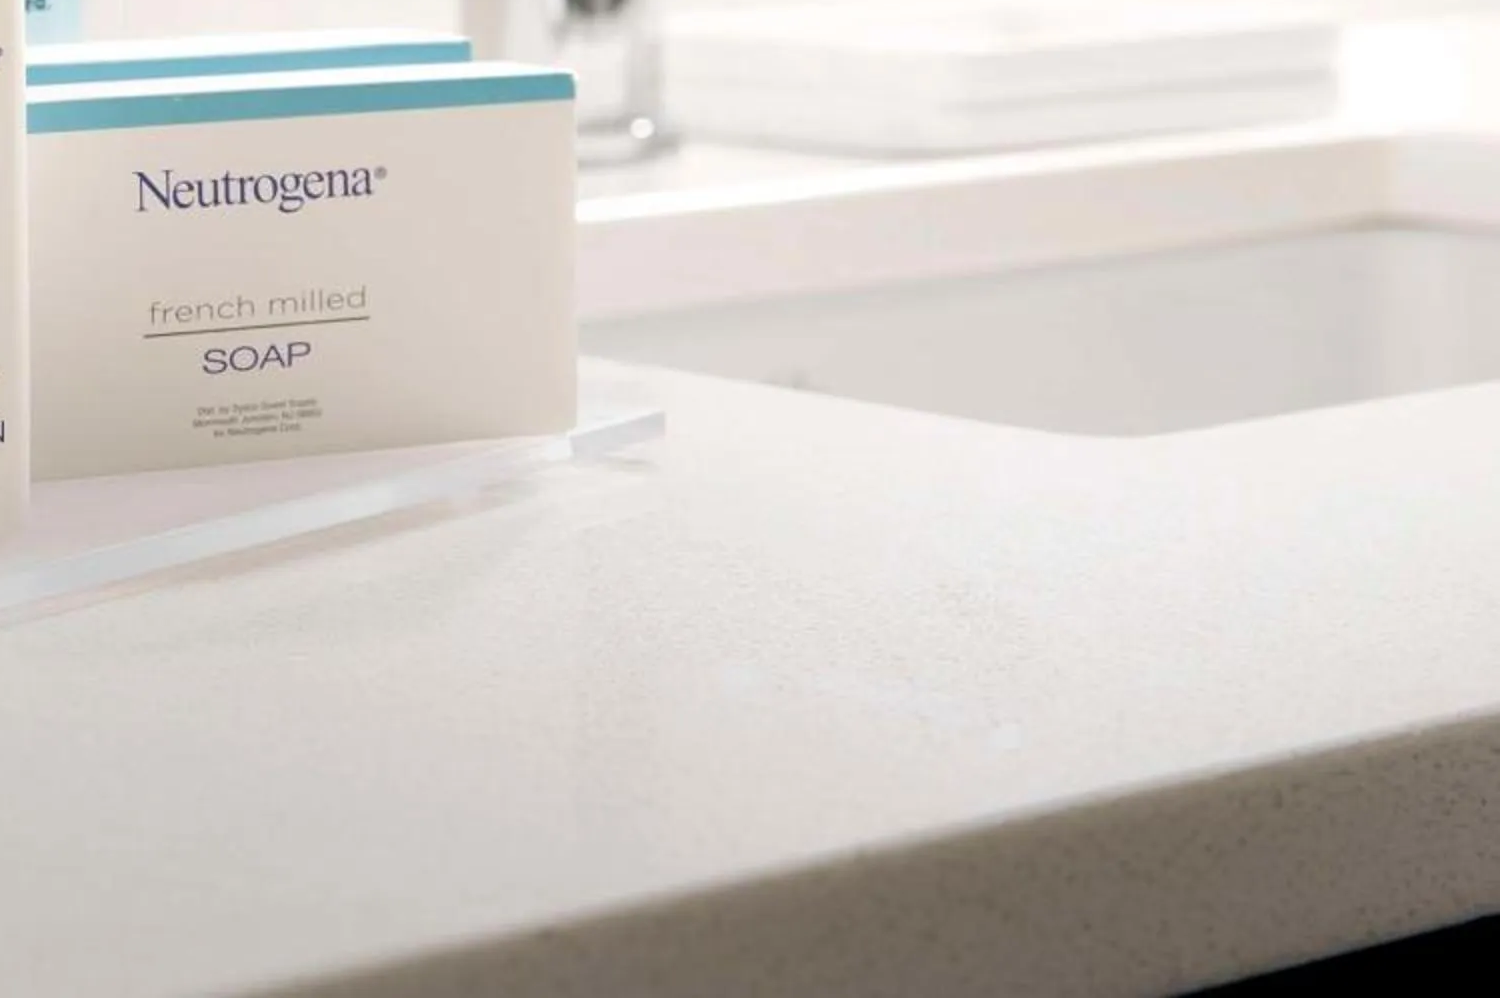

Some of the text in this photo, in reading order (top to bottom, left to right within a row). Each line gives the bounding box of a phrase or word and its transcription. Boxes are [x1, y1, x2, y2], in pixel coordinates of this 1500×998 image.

[150, 286, 367, 326] french milled
[202, 341, 311, 375] SOAP
